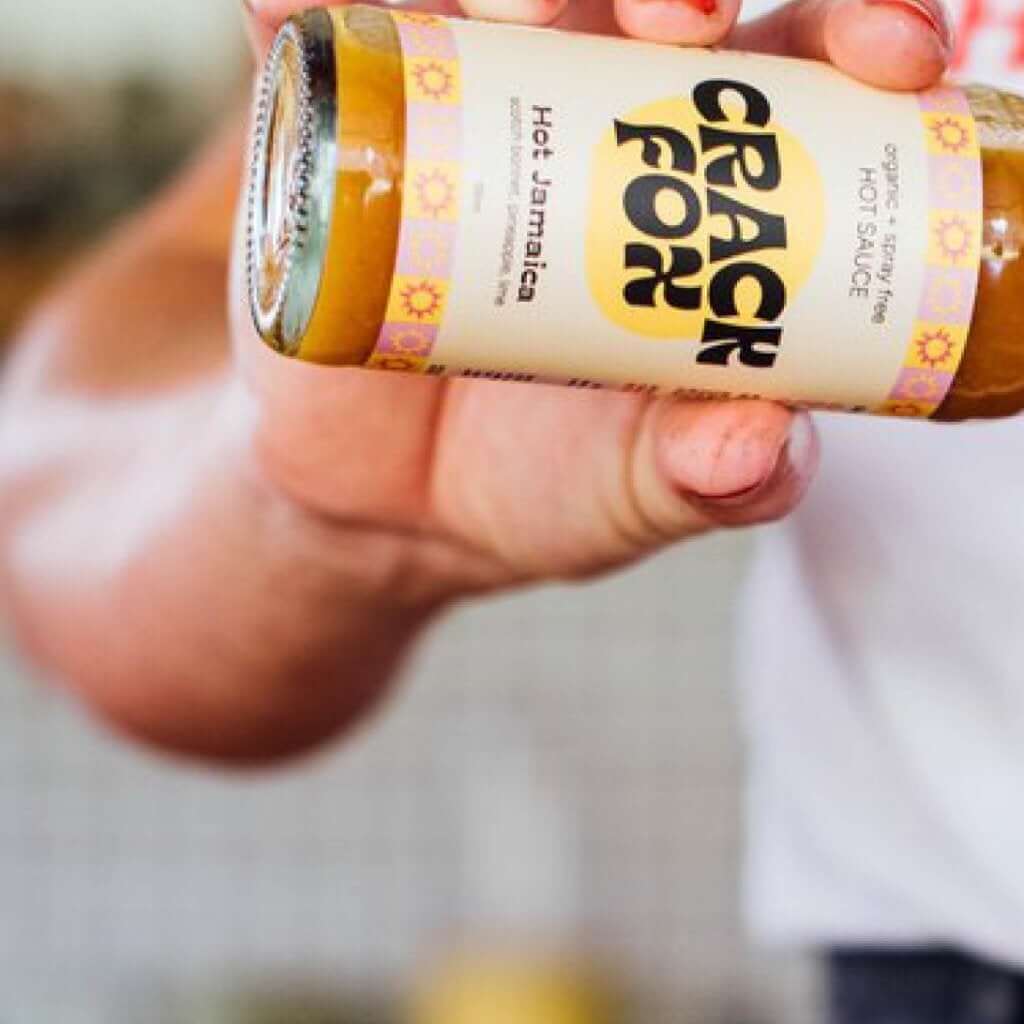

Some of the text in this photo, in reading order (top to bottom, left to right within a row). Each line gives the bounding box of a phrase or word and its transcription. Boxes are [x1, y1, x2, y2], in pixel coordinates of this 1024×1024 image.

[516, 104, 553, 302] Hot Jamaica
[692, 78, 787, 368] CRACK
[881, 143, 899, 209] organic
[849, 167, 877, 297] HOT SAUCE
[876, 233, 896, 284] spray
[871, 288, 893, 324] free
